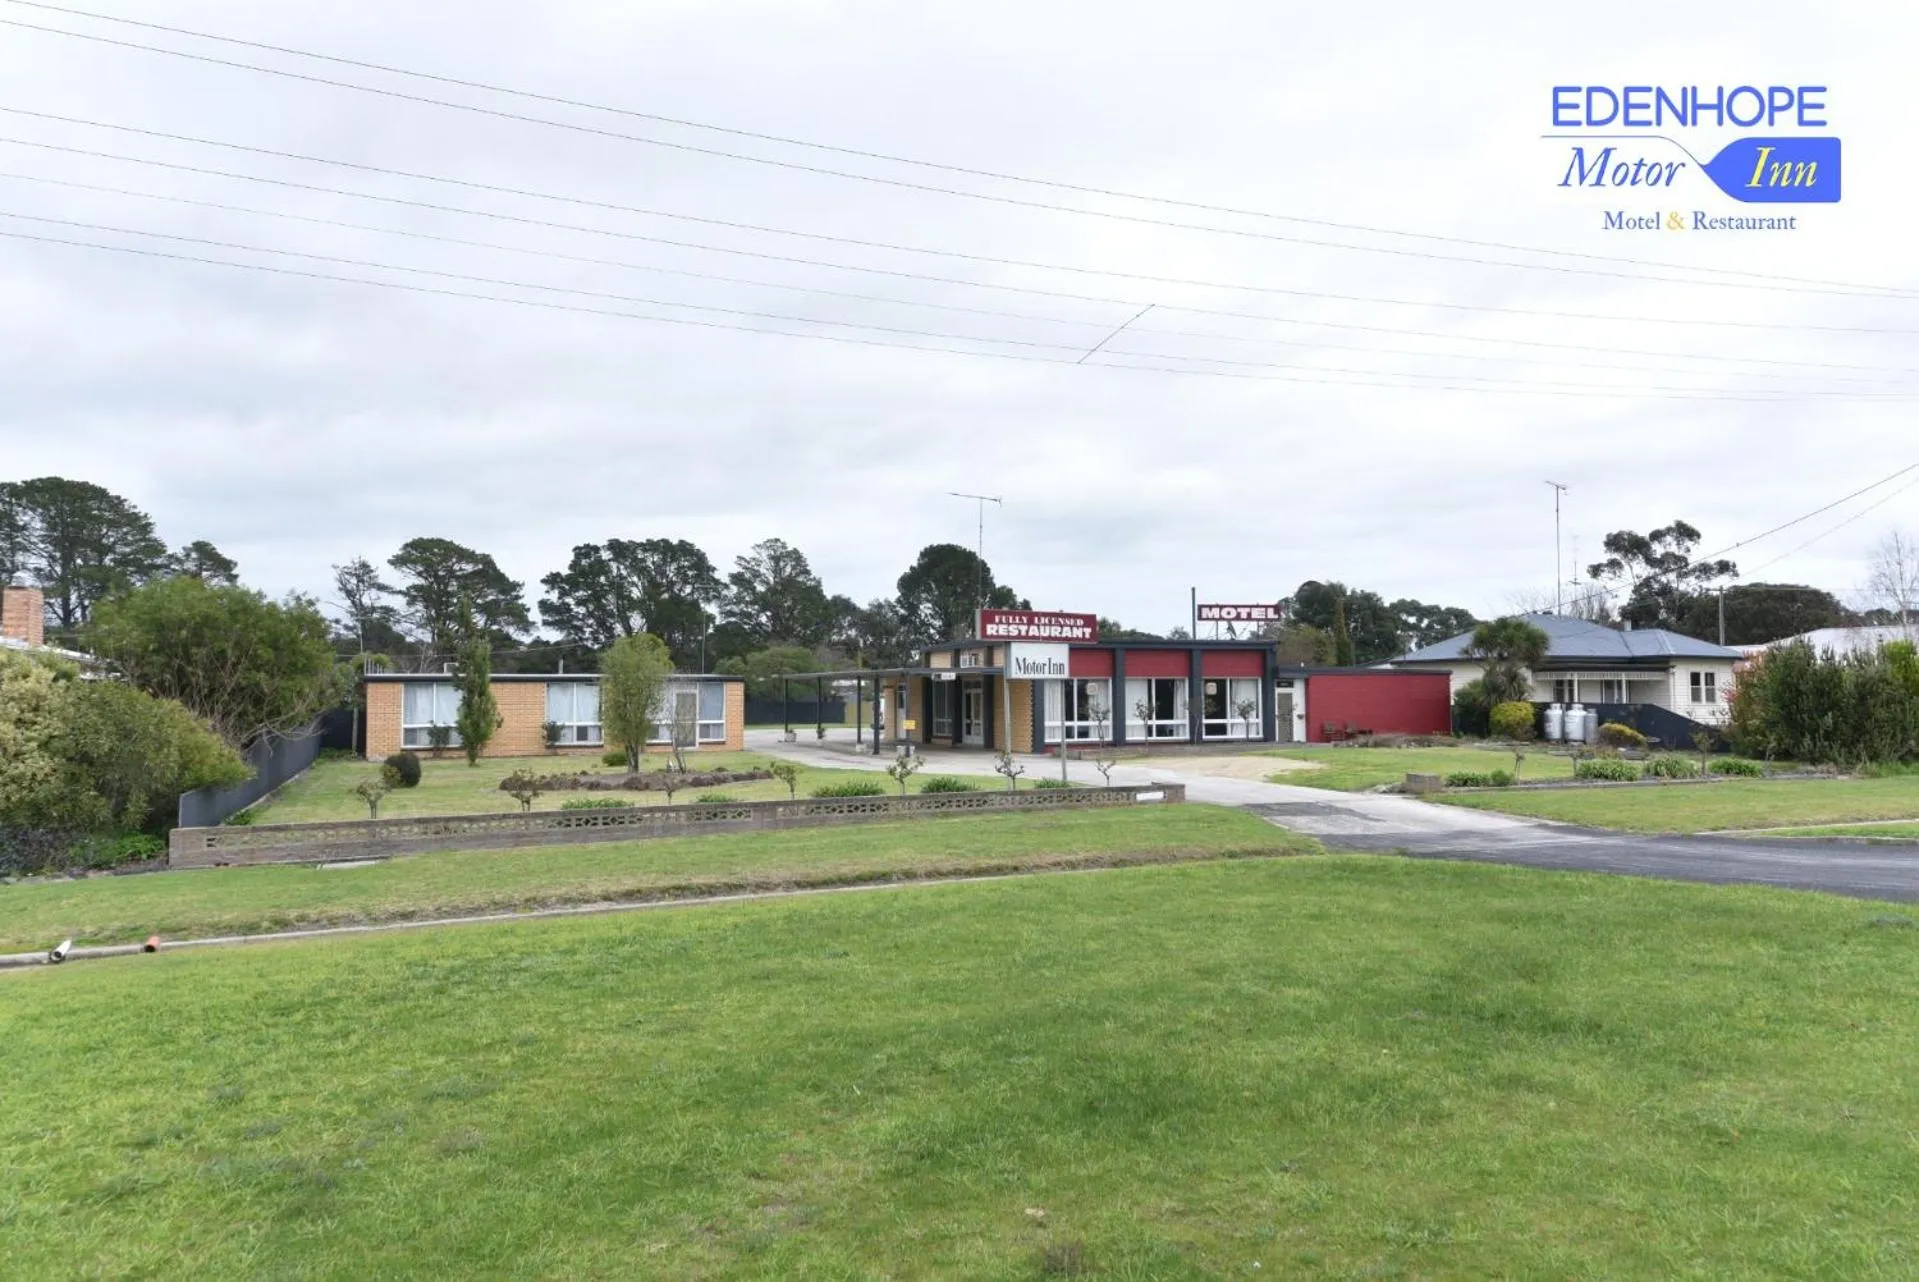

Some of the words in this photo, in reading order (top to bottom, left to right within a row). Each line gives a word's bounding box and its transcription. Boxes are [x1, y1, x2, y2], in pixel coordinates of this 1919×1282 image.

[1201, 607, 1279, 619] MOTEL
[994, 615, 1028, 624] FULLY
[1034, 617, 1084, 627] LICENSED
[986, 624, 1092, 639] RESTAURANT
